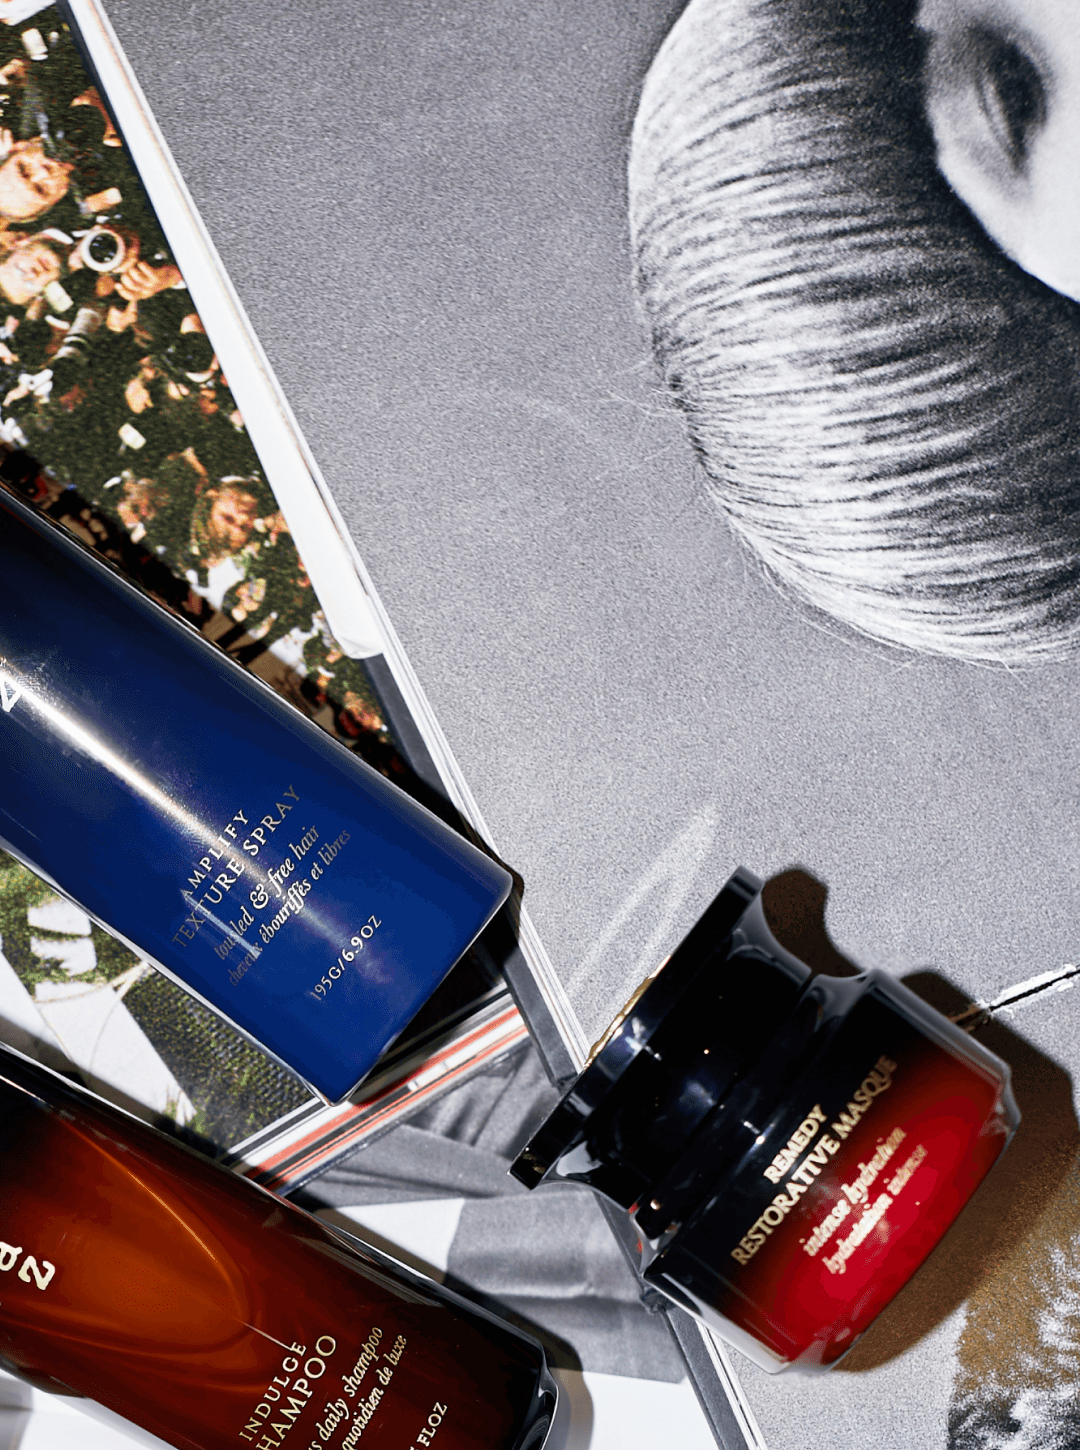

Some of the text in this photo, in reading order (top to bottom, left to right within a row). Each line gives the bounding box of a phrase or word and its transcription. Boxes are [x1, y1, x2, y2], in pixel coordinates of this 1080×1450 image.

[172, 785, 299, 946] TEXTURE SPRAY
[181, 810, 248, 902] AMPLIFY
[214, 827, 318, 959] tousled & free hair
[259, 879, 311, 943] ébouriffés
[311, 863, 323, 880] et
[318, 830, 350, 865] libres
[731, 1056, 897, 1264] RESTORATIVE MASQUE
[764, 1106, 826, 1183] REMEDY
[800, 1127, 906, 1256] intense hydration
[822, 1193, 893, 1274] hydratation
[239, 1342, 306, 1441] INDULGE
[316, 1399, 349, 1440] daily
[342, 1328, 382, 1397] shampoo
[378, 1367, 393, 1385] de
[384, 1336, 406, 1365] luxe
[417, 1402, 447, 1446] FLOZ
